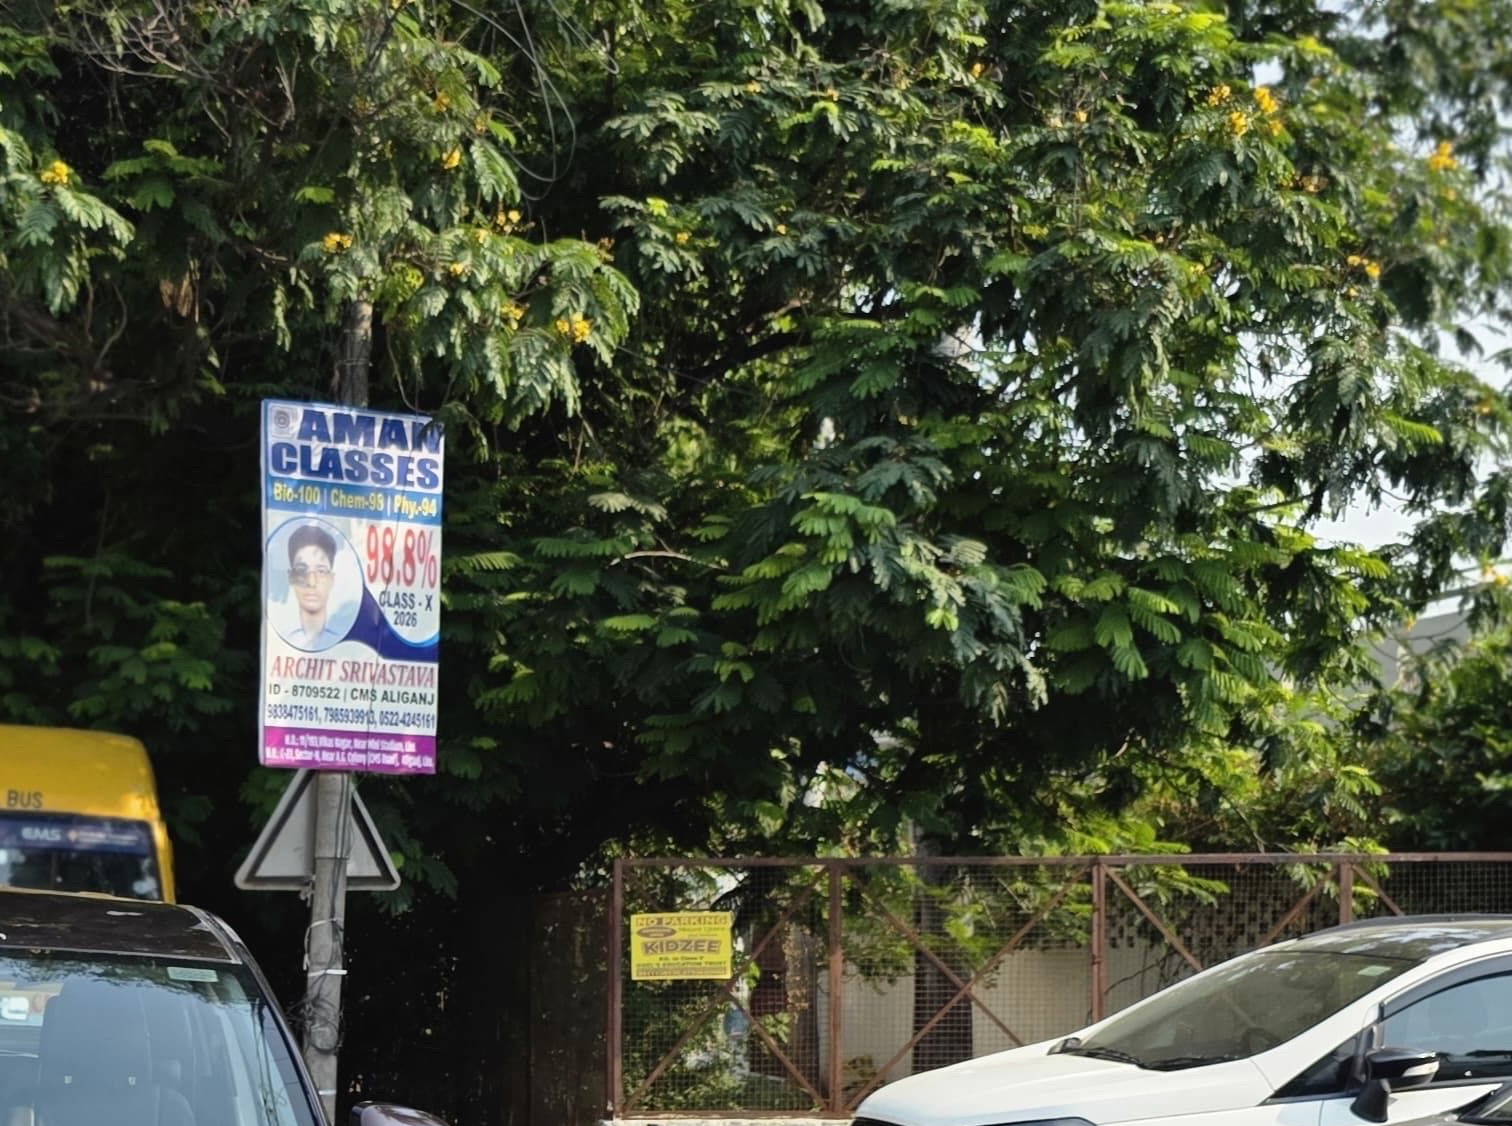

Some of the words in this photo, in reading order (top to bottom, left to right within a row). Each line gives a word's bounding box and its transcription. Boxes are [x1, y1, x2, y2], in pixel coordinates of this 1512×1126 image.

[297, 409, 443, 454] AMAN
[271, 442, 439, 489] CLASSES
[273, 481, 321, 504] Bio-100
[367, 524, 437, 589] 98.8%
[379, 591, 415, 609] CLASS
[425, 595, 433, 611] X
[271, 655, 337, 681] ARCHIT
[339, 660, 436, 689] SRIVASTAVA
[269, 684, 281, 695] ID
[350, 688, 377, 702] CMS
[381, 690, 436, 706] ALIGANJ
[6, 789, 43, 808] BUS
[643, 939, 721, 955] KIDZEE
